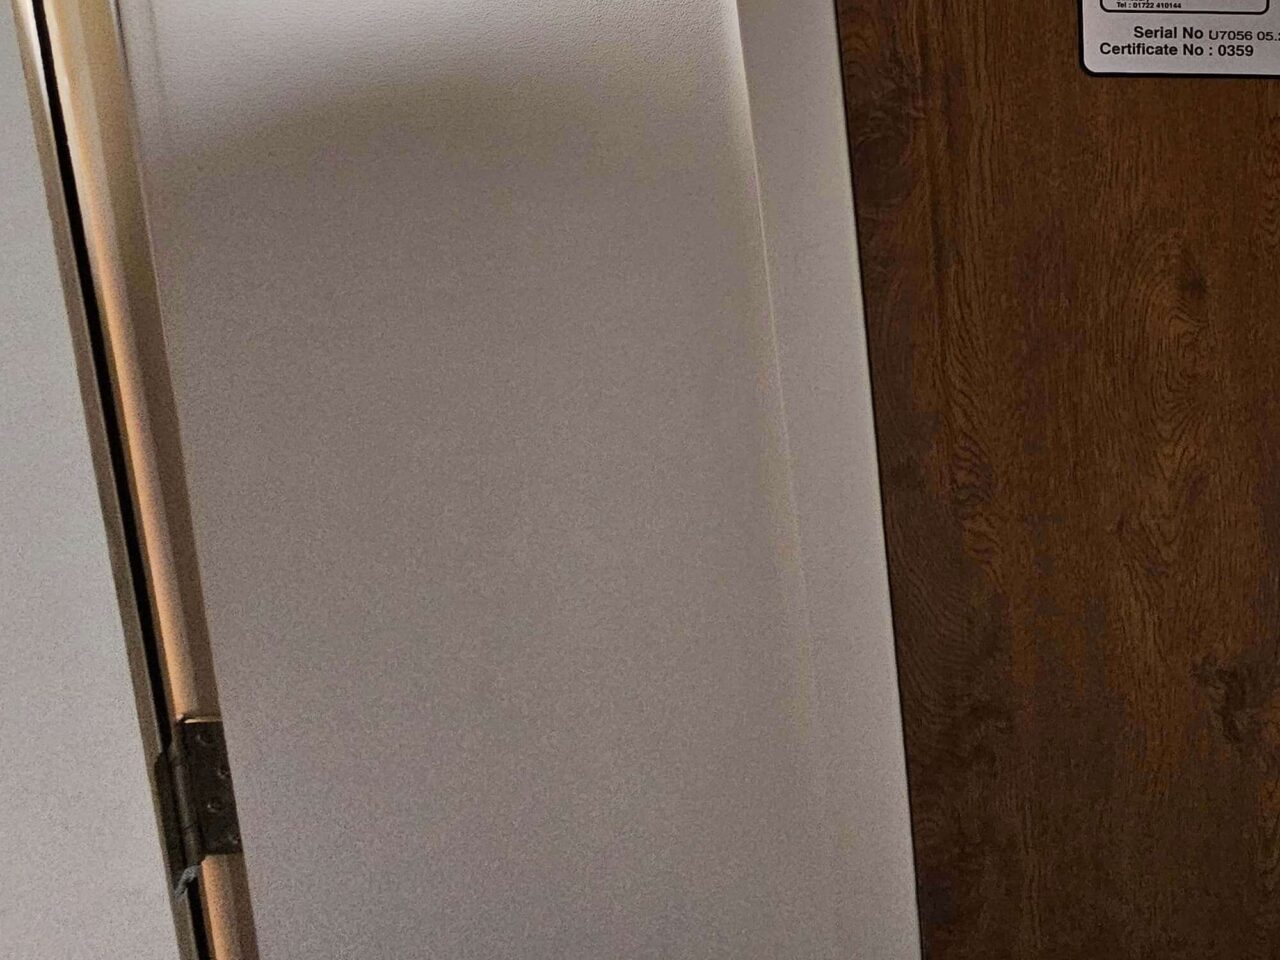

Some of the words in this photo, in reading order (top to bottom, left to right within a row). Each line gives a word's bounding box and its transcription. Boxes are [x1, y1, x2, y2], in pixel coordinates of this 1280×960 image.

[1133, 26, 1177, 39] Serial
[1182, 27, 1204, 39] No
[1208, 30, 1253, 41] U7056
[1100, 43, 1178, 55] Certificate
[1183, 44, 1204, 56] No
[1218, 45, 1254, 57] 0359
